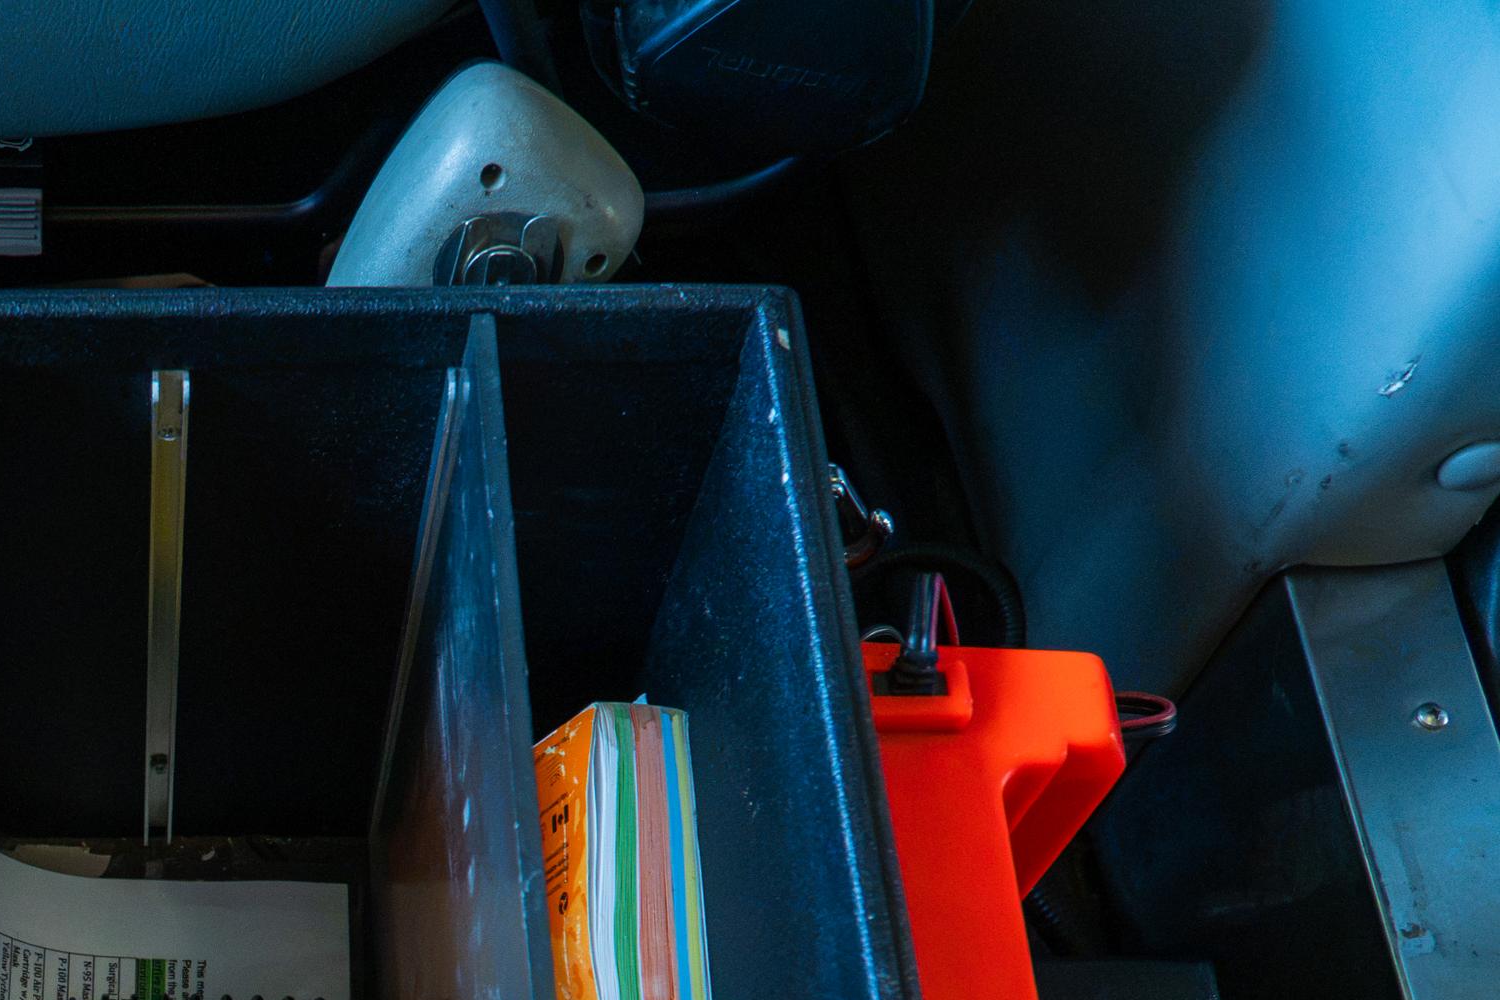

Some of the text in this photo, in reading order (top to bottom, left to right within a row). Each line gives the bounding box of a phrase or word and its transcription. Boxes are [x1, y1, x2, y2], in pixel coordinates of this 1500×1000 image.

[1, 941, 11, 972] Yellow
[12, 945, 21, 968] Mask
[19, 948, 31, 988] Cartridge
[34, 952, 44, 978] P-100
[168, 960, 177, 979] from
[58, 957, 67, 983] P-100
[83, 961, 91, 982] N-95
[107, 962, 118, 995] Surgical
[182, 960, 192, 989] Please
[33, 979, 42, 992] Air
[168, 981, 177, 996] the
